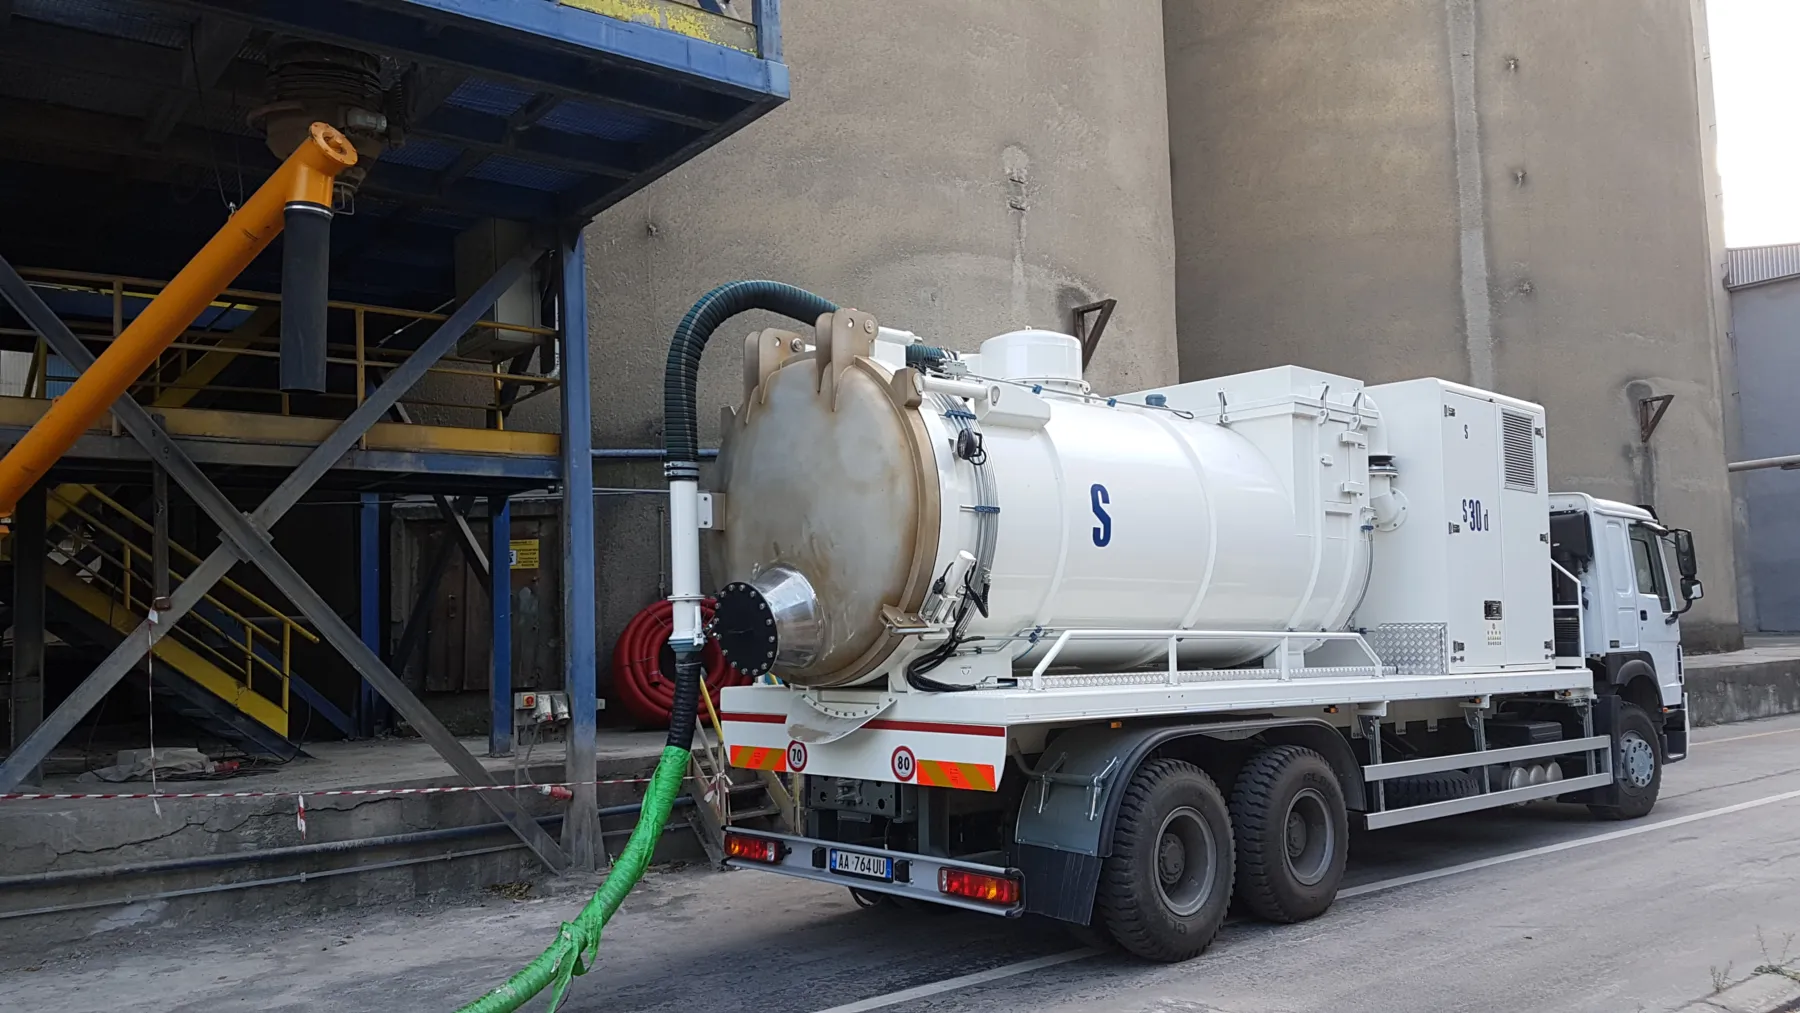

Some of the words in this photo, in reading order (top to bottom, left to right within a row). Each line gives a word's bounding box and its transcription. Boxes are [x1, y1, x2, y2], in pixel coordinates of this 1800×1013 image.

[1464, 424, 1469, 439] S
[1090, 483, 1112, 548] S
[792, 749, 802, 762] 70
[897, 756, 910, 771] 80
[838, 853, 850, 870] AA
[854, 856, 885, 875] 764UU
